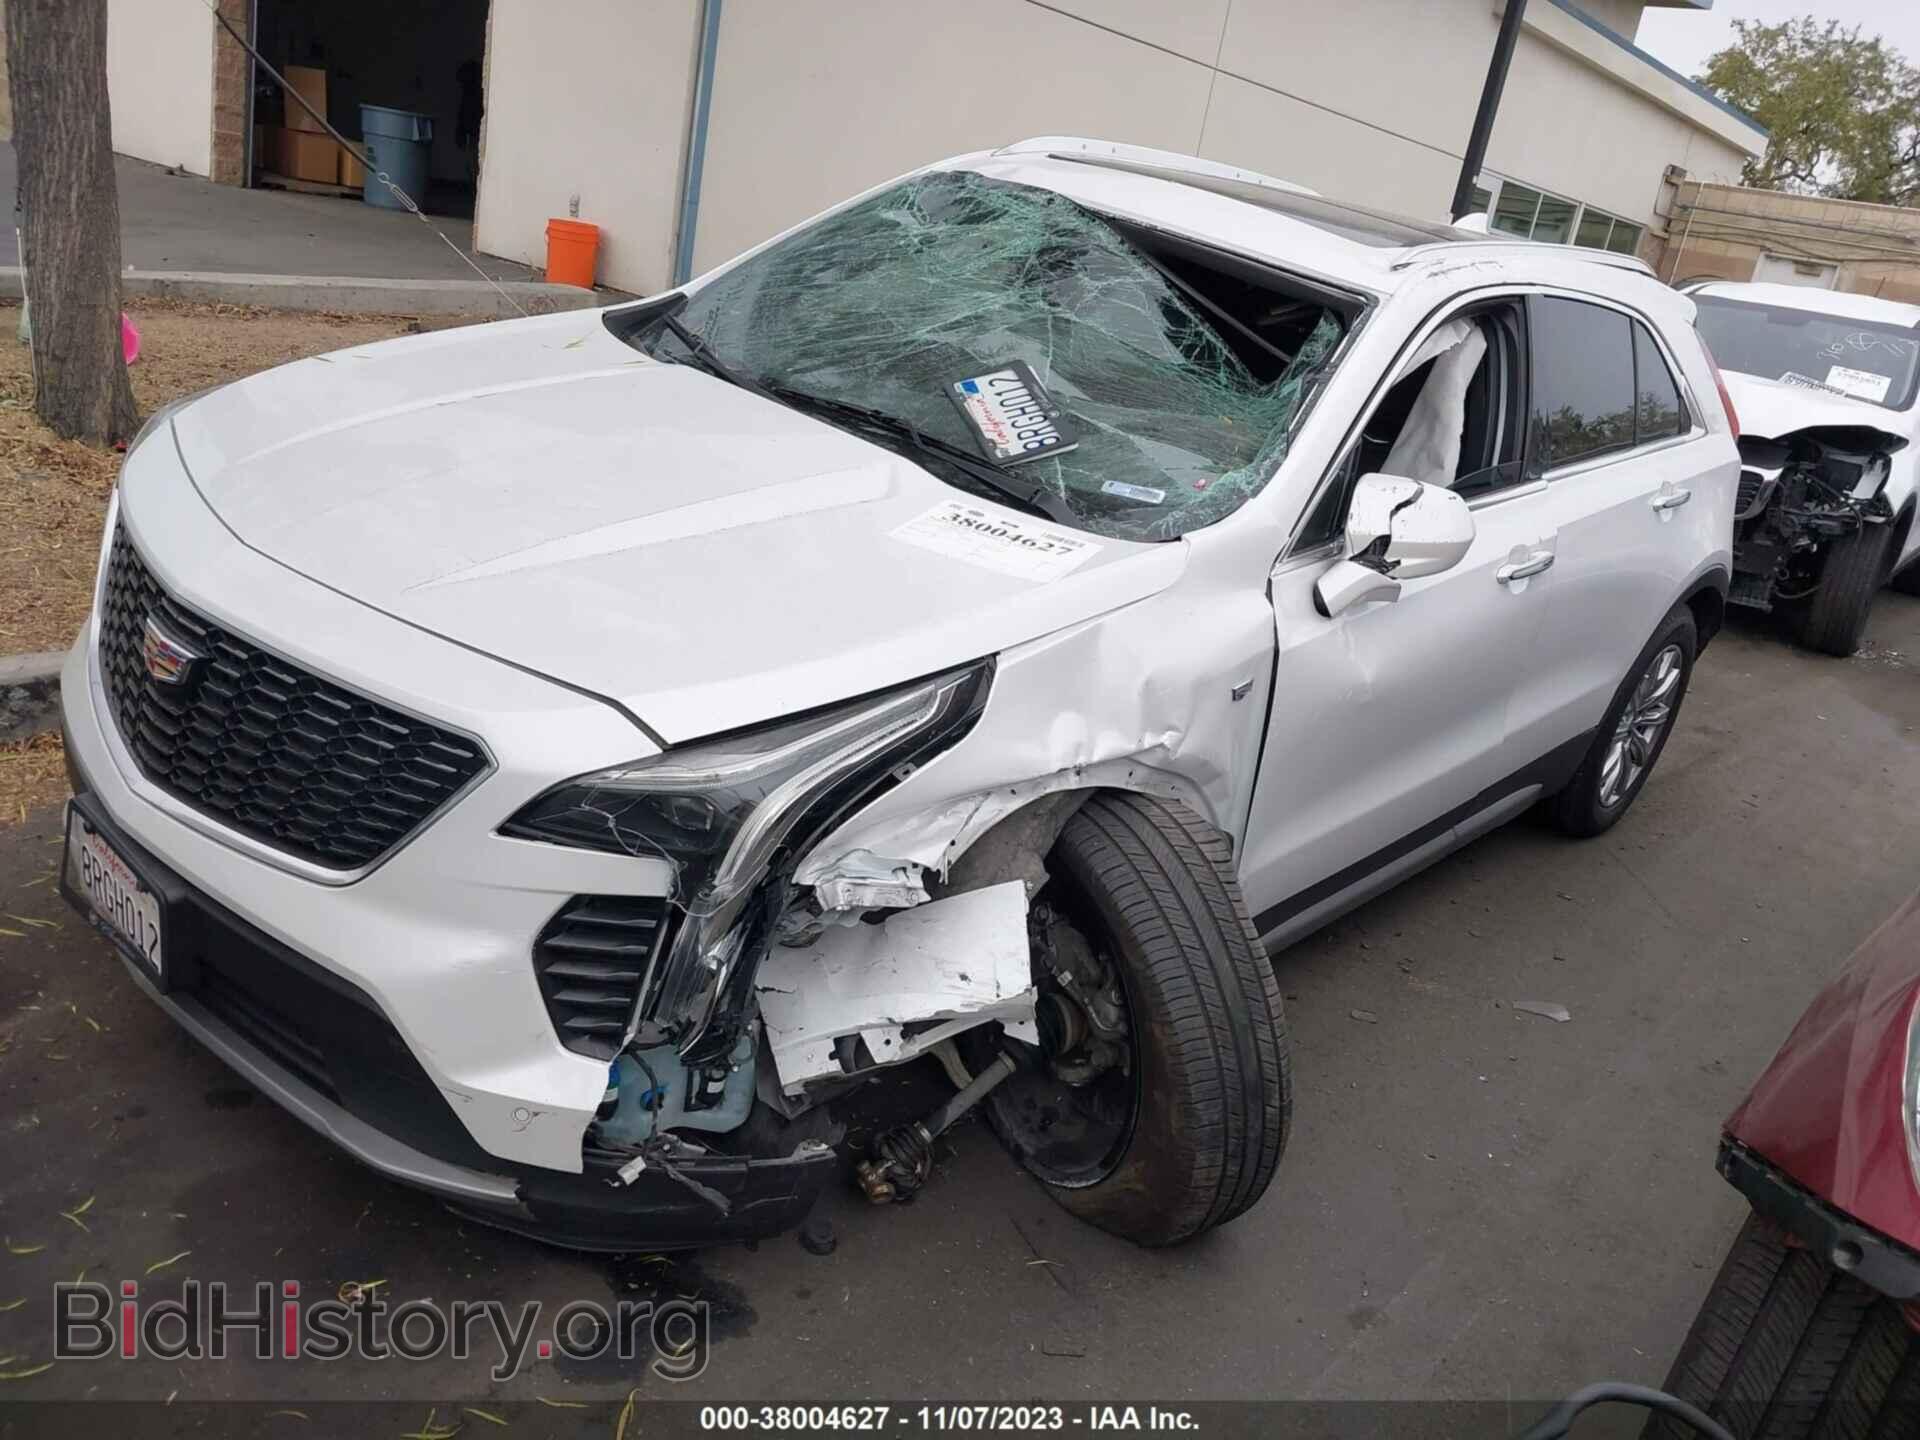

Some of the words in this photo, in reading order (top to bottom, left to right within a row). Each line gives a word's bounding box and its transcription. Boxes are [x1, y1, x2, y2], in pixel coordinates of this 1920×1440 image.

[988, 378, 1061, 450] 8RGH012
[942, 512, 1073, 556] 38004627
[82, 845, 159, 972] 8RGH012
